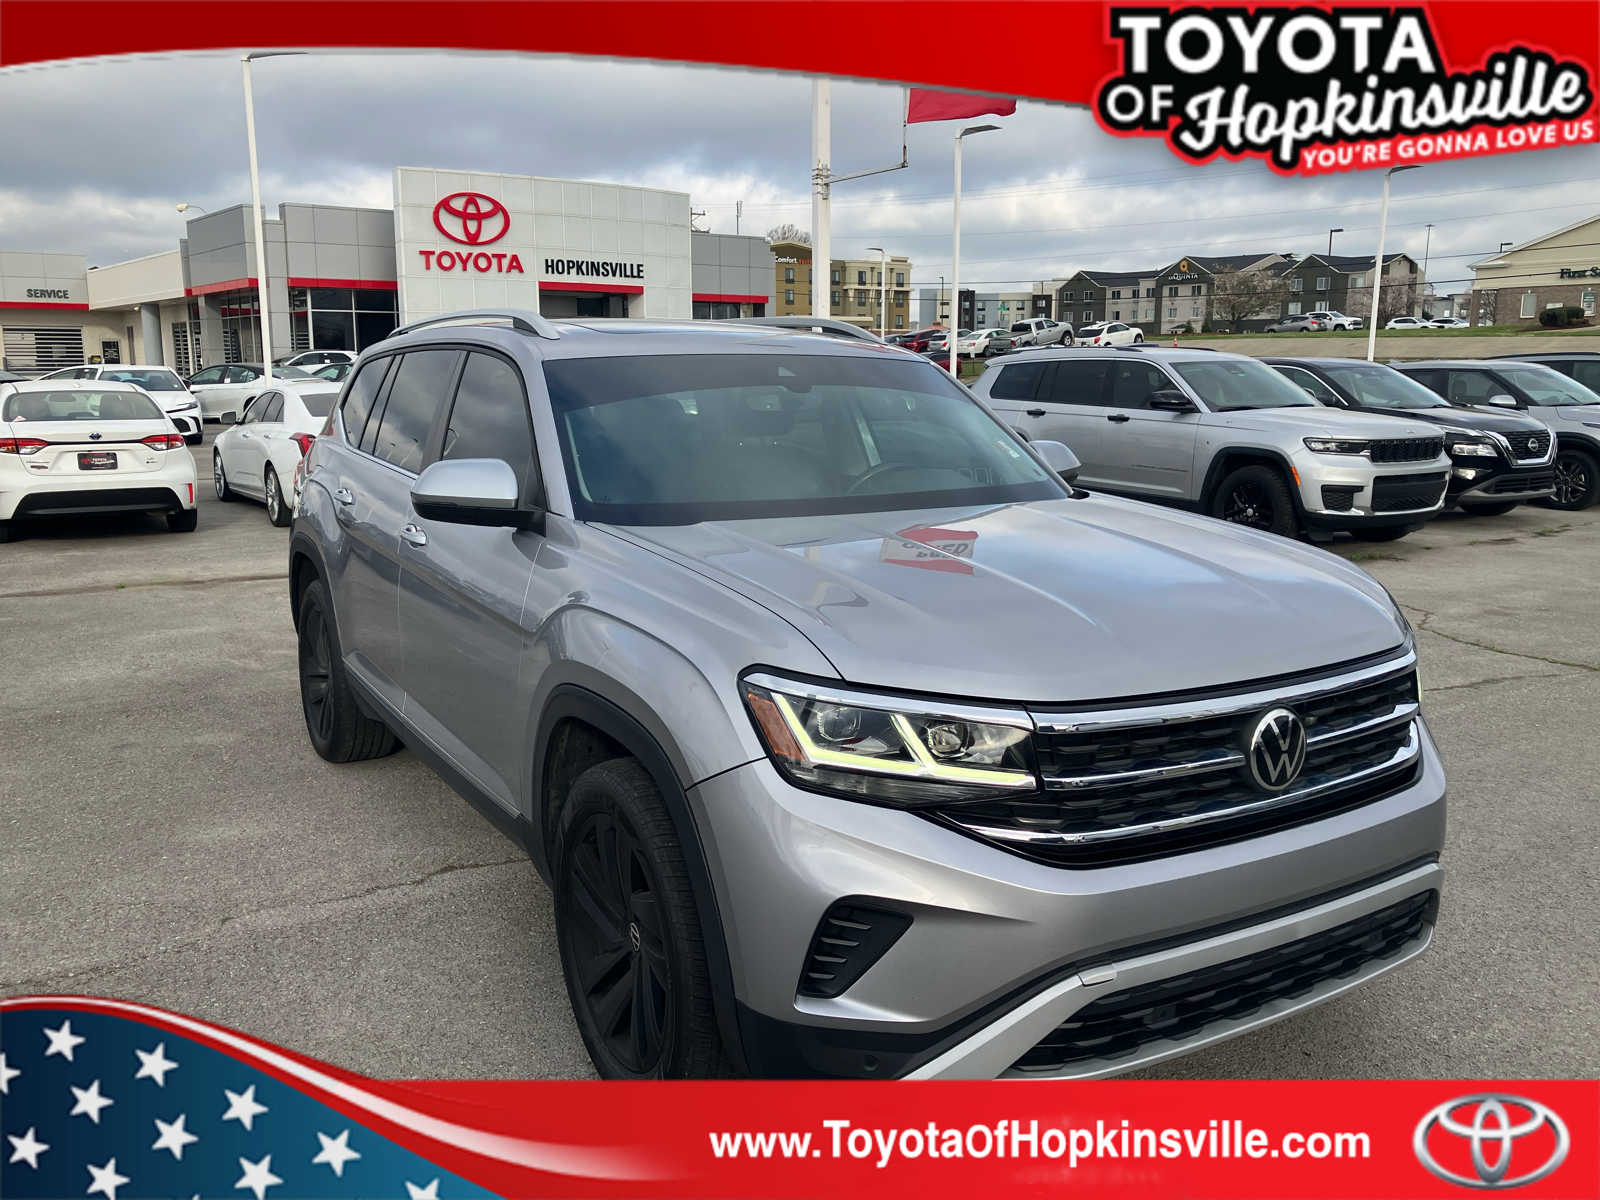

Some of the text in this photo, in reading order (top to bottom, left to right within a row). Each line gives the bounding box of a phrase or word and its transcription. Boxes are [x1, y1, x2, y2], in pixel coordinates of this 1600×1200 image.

[419, 250, 524, 273] TOYOTA
[544, 258, 644, 279] HOPKINSVILLE
[26, 288, 70, 299] SERVICE
